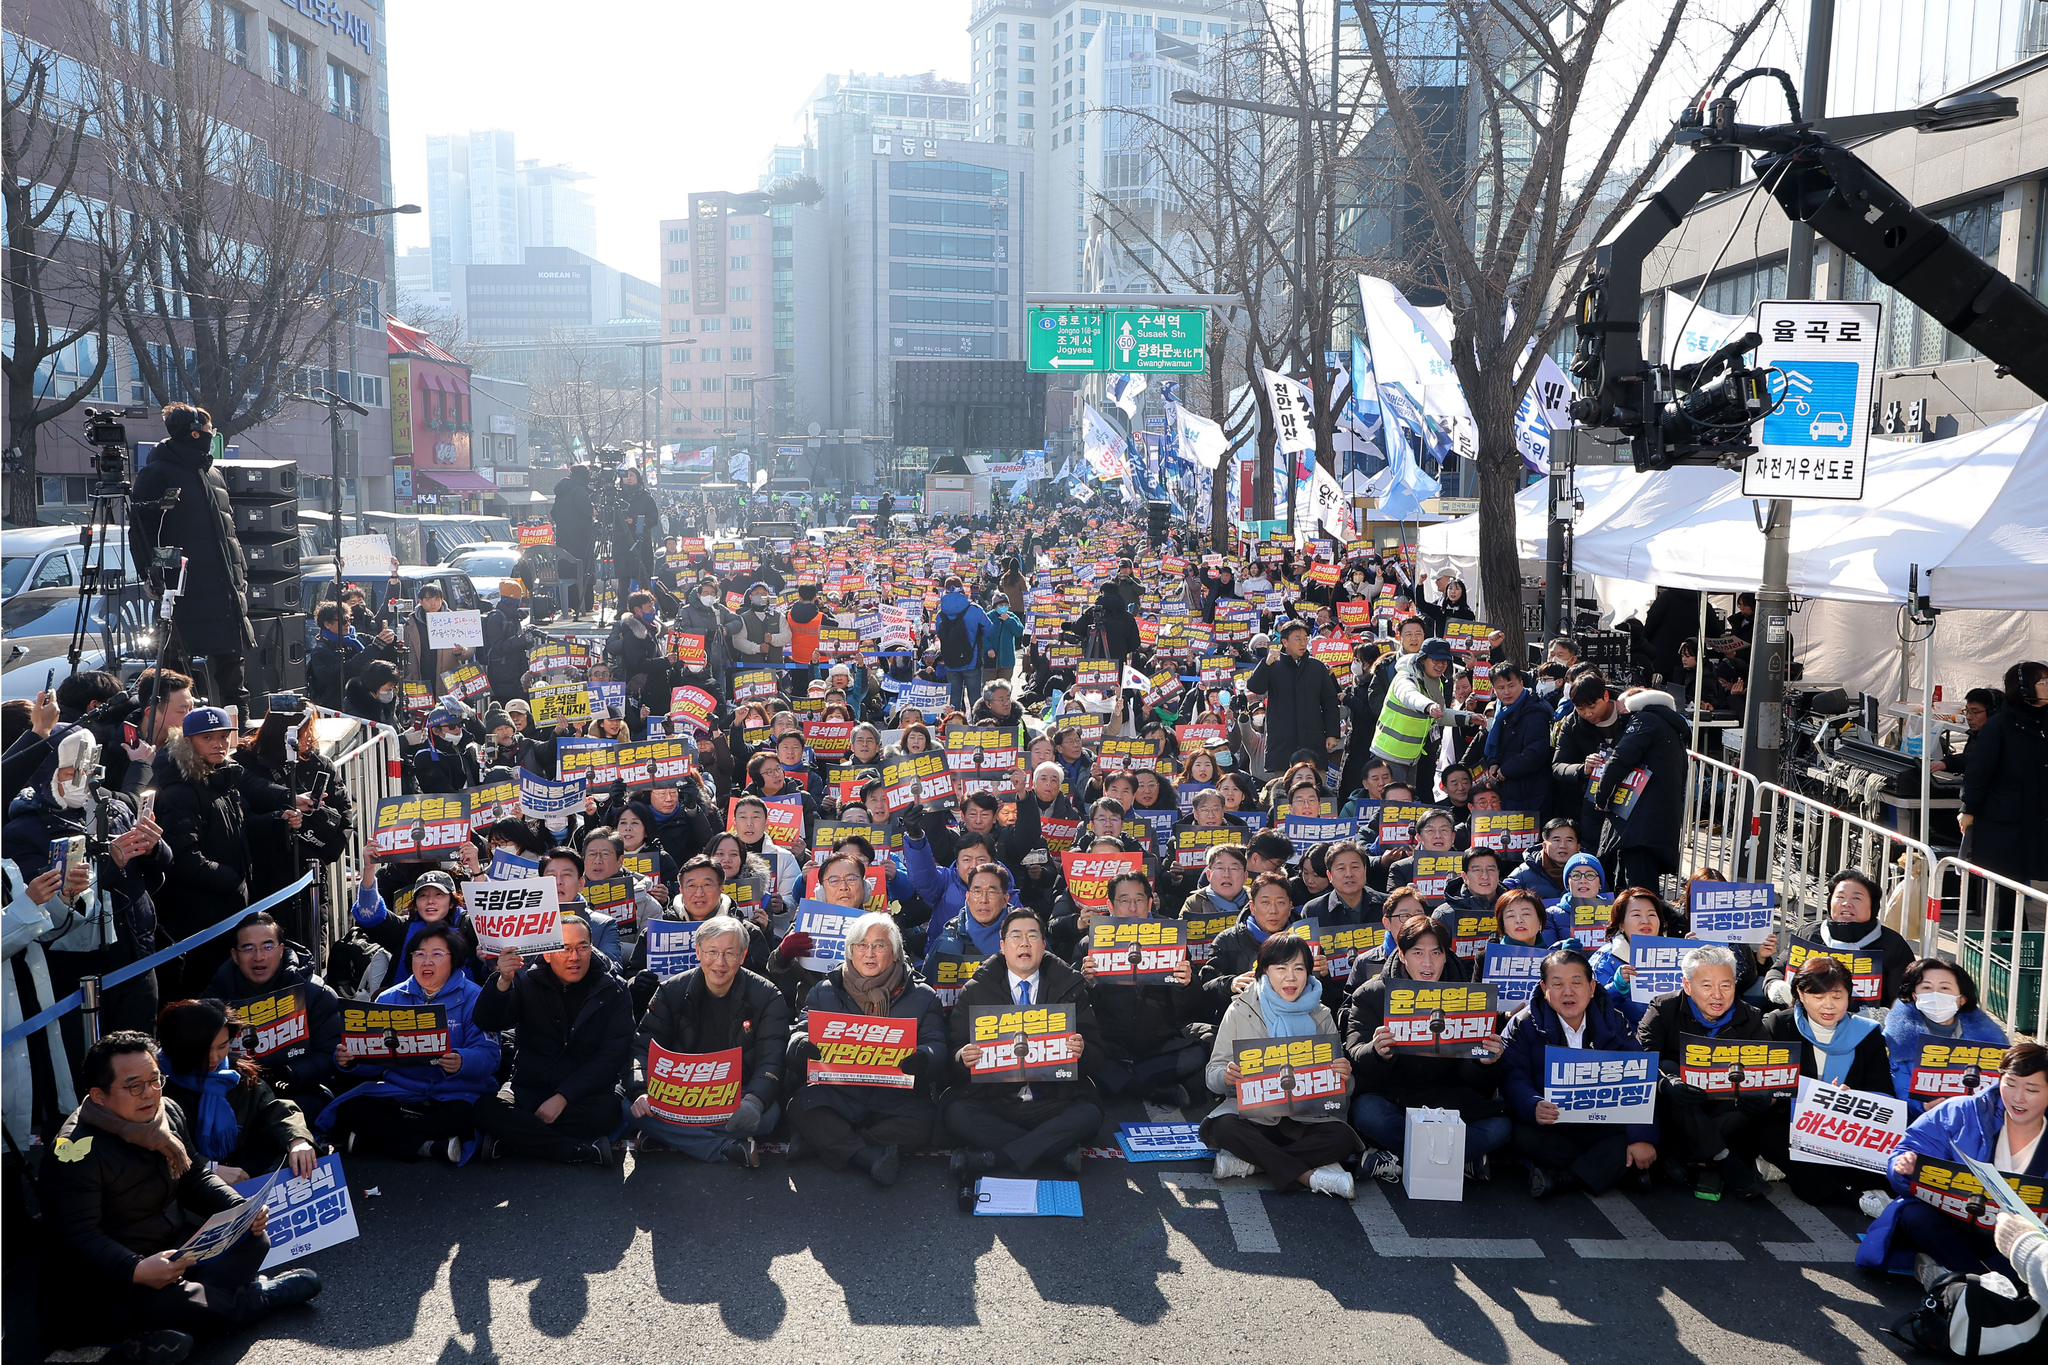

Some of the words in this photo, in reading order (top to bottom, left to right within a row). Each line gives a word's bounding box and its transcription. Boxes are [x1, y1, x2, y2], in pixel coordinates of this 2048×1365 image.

[902, 138, 938, 157] 동일
[1044, 320, 1051, 328] 6
[1137, 315, 1180, 329] 수색역
[1057, 327, 1080, 336] Jongno
[1137, 330, 1168, 338] Susaek
[1171, 330, 1186, 338] Stn
[1772, 320, 1861, 343] 율곡로
[1057, 335, 1093, 347] 조계사
[1121, 338, 1132, 347] 50
[1056, 346, 1092, 354] Jogyesa
[1137, 360, 1192, 368] Gwanghwamun
[397, 376, 410, 440] 서울커피
[1755, 457, 1854, 480] 자전거우선도로
[519, 534, 553, 545] 파면하라!
[522, 528, 550, 537] 윤석열을
[715, 550, 750, 562] 윤석열을
[1165, 557, 1187, 567] 윤석열을
[714, 561, 751, 571] 파면하라!
[1314, 565, 1339, 574] 윤석열을
[1310, 571, 1341, 582] 파면하라!
[1340, 605, 1364, 614] 윤석열을
[1036, 617, 1069, 627] 윤석열을
[1215, 622, 1249, 632] 윤석열을
[1447, 623, 1495, 638] 윤석열을
[819, 629, 857, 640] 윤석열을
[1158, 637, 1187, 647] 윤석열을
[819, 641, 860, 652] 파면하라!
[1052, 647, 1083, 656] 윤석열을
[1317, 641, 1350, 652] 윤석열을
[1079, 661, 1116, 671] 윤석열을
[1202, 657, 1234, 668] 윤석열을
[1314, 652, 1354, 663] 파면하라!
[444, 666, 480, 690] 윤석열을
[734, 671, 773, 687] 윤석열을
[1077, 672, 1119, 684] 파면하라!
[734, 681, 777, 698] 파면하라!
[911, 684, 947, 697] 내란종식
[545, 694, 577, 707] 윤석열
[676, 688, 712, 709] 윤석열을
[908, 695, 950, 709] 국정안정!
[207, 711, 219, 725] LA
[540, 704, 586, 718] 끝장내자!
[1058, 715, 1100, 727] 윤석열을
[808, 725, 848, 737] 윤석열을
[1183, 727, 1220, 738] 윤석열을
[949, 730, 1013, 750] 윤석열을
[1101, 740, 1155, 756] 윤석열을
[563, 749, 616, 770] 윤석열을
[618, 742, 683, 766] 윤석열을
[946, 750, 1016, 771] 파면하라!
[620, 758, 689, 784] 파면하라!
[883, 756, 944, 787] 윤석열을
[1100, 756, 1158, 771] 파면하라!
[523, 777, 581, 799] 내란종식
[886, 772, 953, 807] 파면하라!
[521, 793, 584, 812] 국정안정!
[379, 797, 463, 829] 윤석열을
[1289, 822, 1352, 840] 내란종식
[1475, 814, 1535, 833] 윤석열을
[376, 822, 470, 852] 파면하라!
[1179, 830, 1242, 848] 윤석열을
[1071, 859, 1133, 877] 윤석열을
[426, 873, 436, 882] R
[474, 889, 544, 911] 국힘당을
[1696, 889, 1769, 910] 내란종식
[474, 911, 557, 938] 해산하라!
[1696, 911, 1771, 932] 국정안정!
[1094, 923, 1178, 947] 윤석열을
[1092, 948, 1184, 972] 파면하라!
[1390, 988, 1487, 1014] 윤석열을
[344, 1008, 437, 1033] 윤석열을
[974, 1009, 1067, 1042] 윤석열을
[1388, 1015, 1493, 1043] 파면하라!
[821, 1020, 905, 1044] 윤석열을
[342, 1031, 448, 1057] 파면하라!
[811, 1042, 914, 1067] 파면하라!
[975, 1036, 1074, 1070] 파면하라!
[1238, 1039, 1334, 1076] 윤석열을
[1684, 1044, 1790, 1068] 윤석열을
[655, 1056, 731, 1083] 윤석열을
[1055, 1070, 1072, 1079] 민주당
[1551, 1059, 1649, 1086] 내란종식
[1240, 1064, 1342, 1105] 파면하라!
[1684, 1068, 1797, 1091] 파면하라!
[648, 1077, 737, 1109] 파면하라!
[1553, 1084, 1651, 1111] 국정안정!
[1324, 1102, 1340, 1111] 민주당
[1812, 1088, 1895, 1126] 국힘당을
[1588, 1113, 1607, 1122] 민주당
[1796, 1110, 1903, 1156] 해산하라!
[290, 1242, 312, 1257] 민주당
